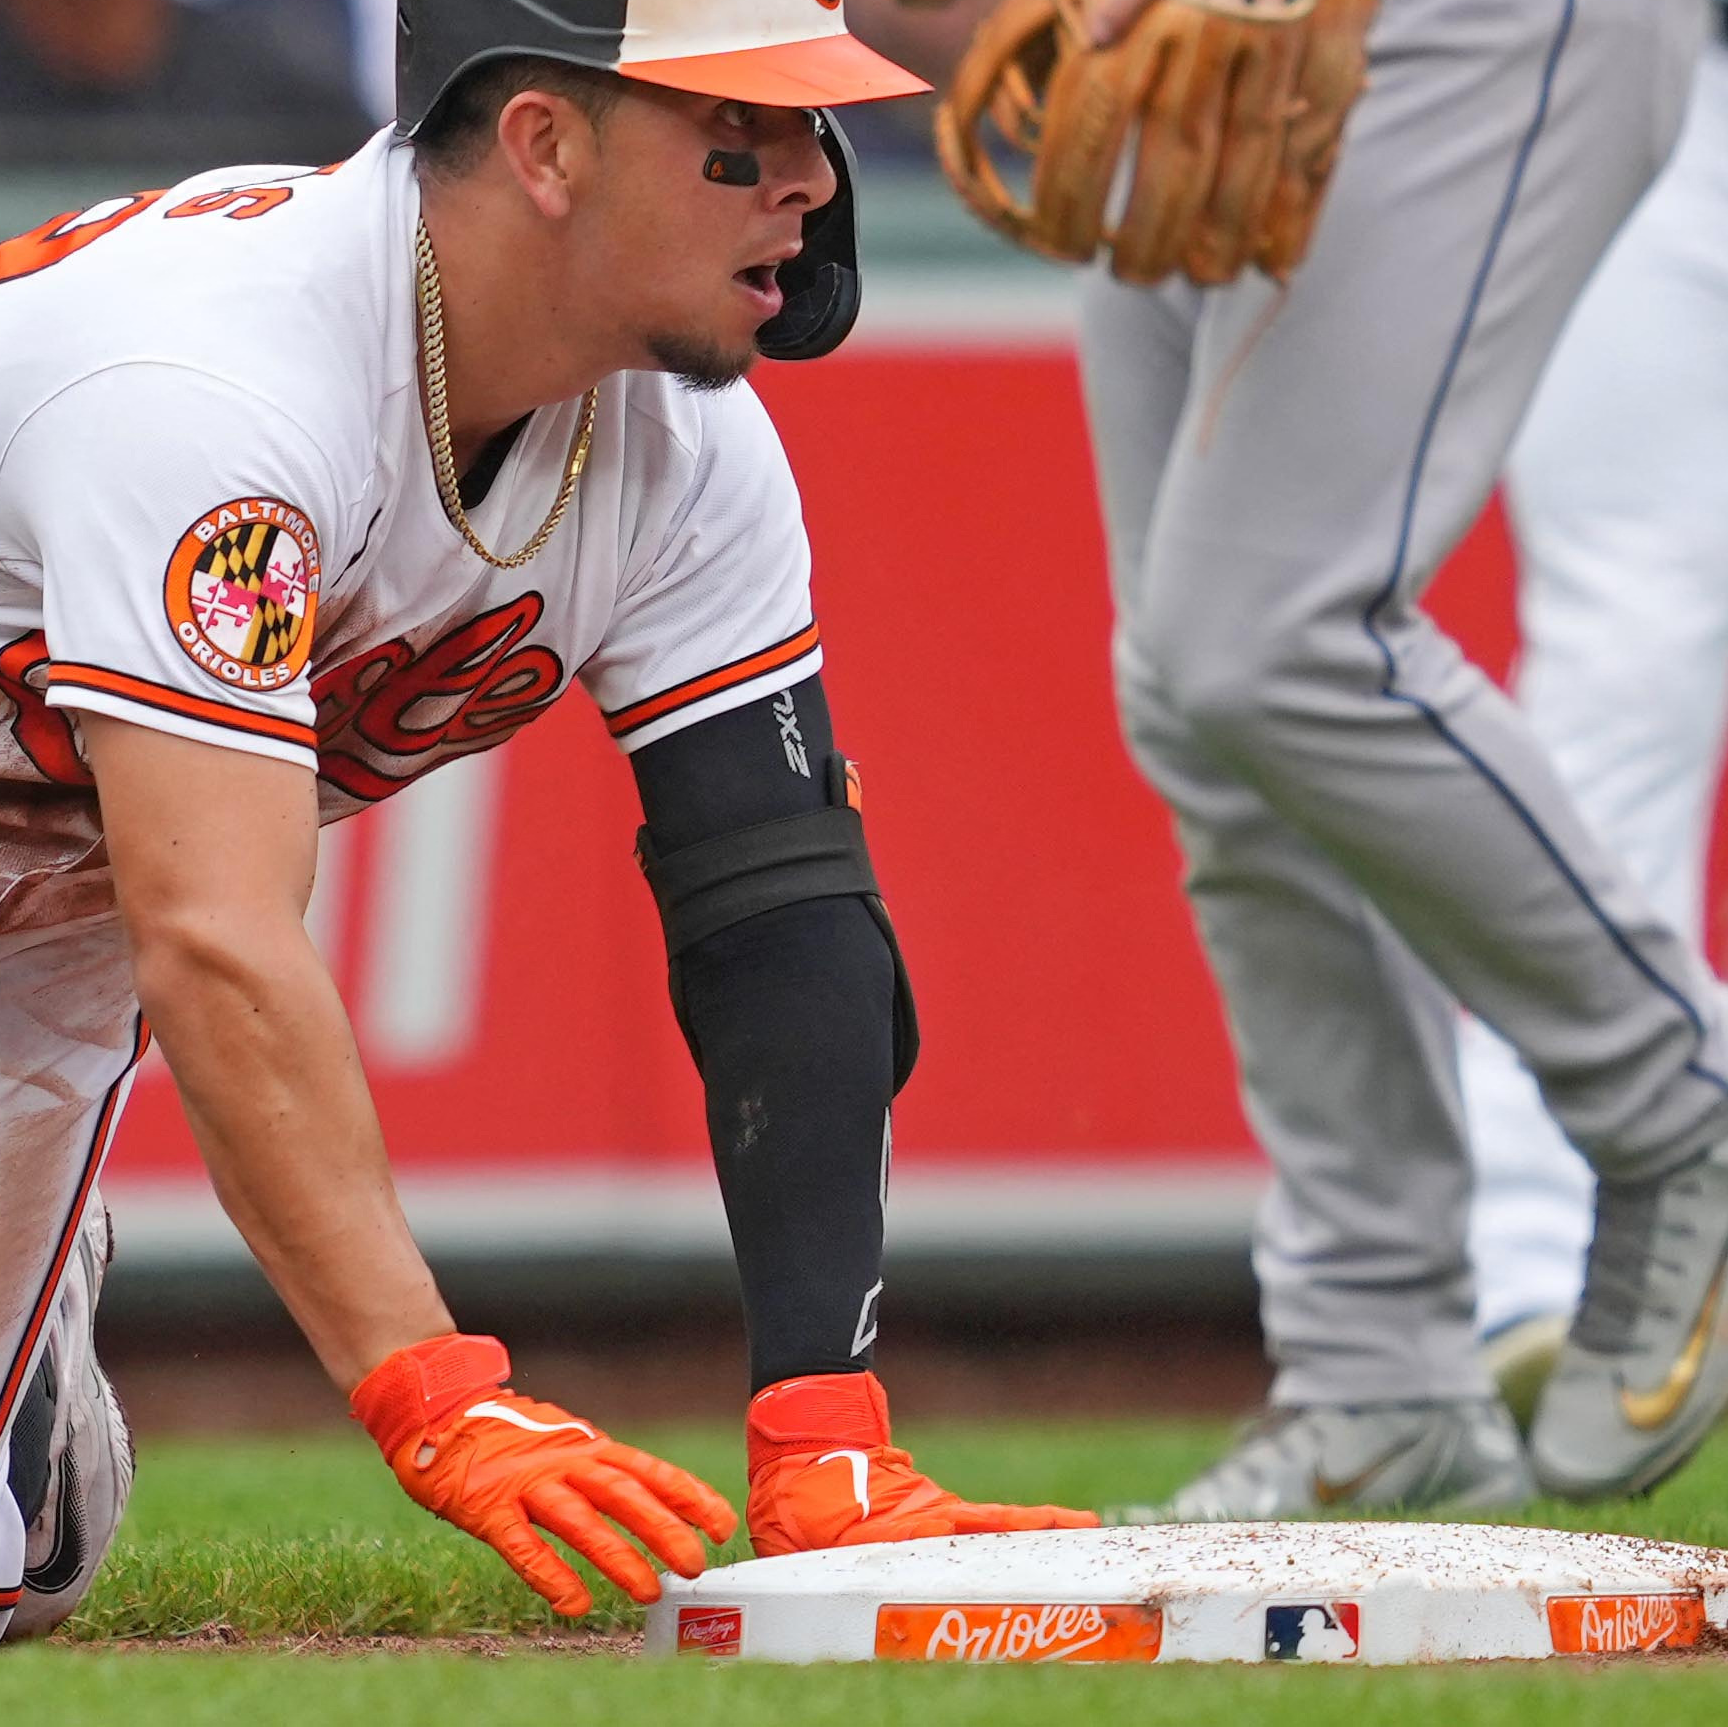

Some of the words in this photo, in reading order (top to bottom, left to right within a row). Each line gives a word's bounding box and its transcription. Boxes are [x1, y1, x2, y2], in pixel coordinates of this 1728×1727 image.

[192, 501, 321, 594] BALTIMORE
[177, 621, 292, 688] ORIOLES
[925, 1604, 1107, 1662] Orioles
[1580, 1595, 1677, 1651] Orioles
